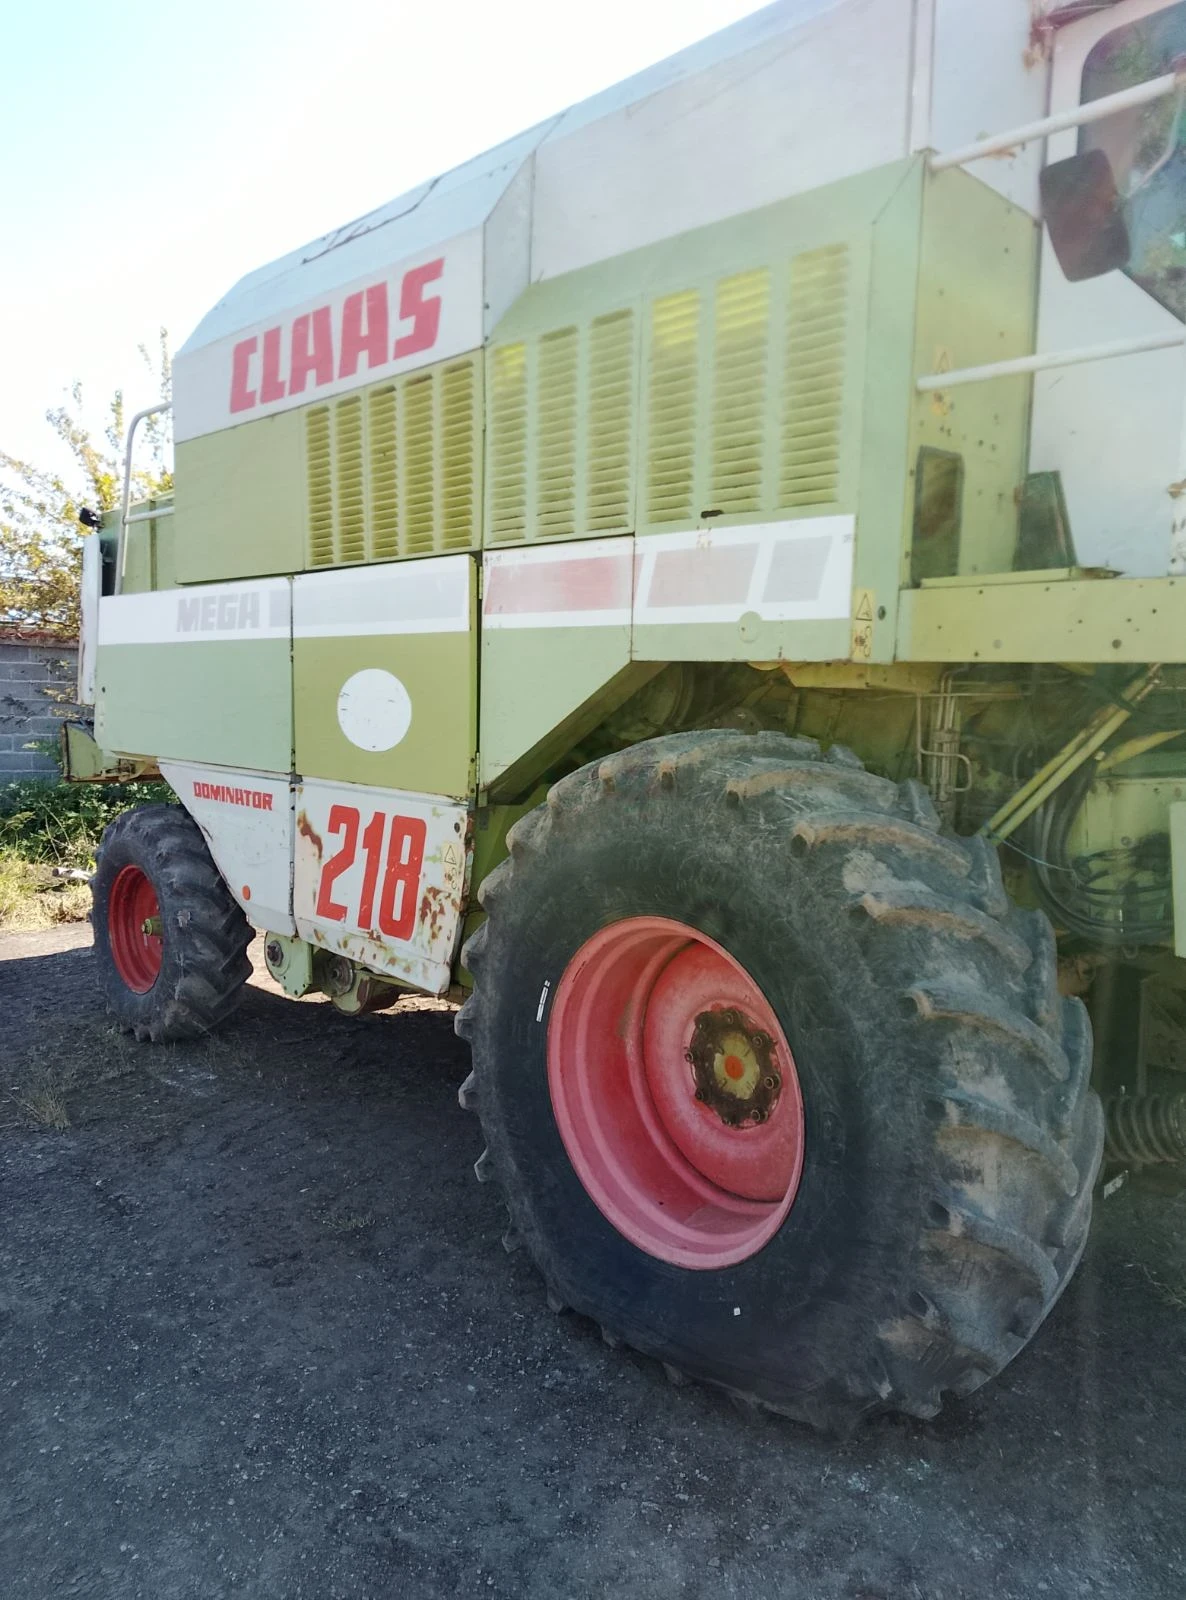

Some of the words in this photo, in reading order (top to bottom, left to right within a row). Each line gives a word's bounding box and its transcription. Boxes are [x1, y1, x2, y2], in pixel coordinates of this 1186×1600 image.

[229, 257, 445, 414] CLAAS
[177, 592, 260, 632] MEGA
[193, 781, 273, 811] DOMINATOR
[316, 804, 427, 941] 218
